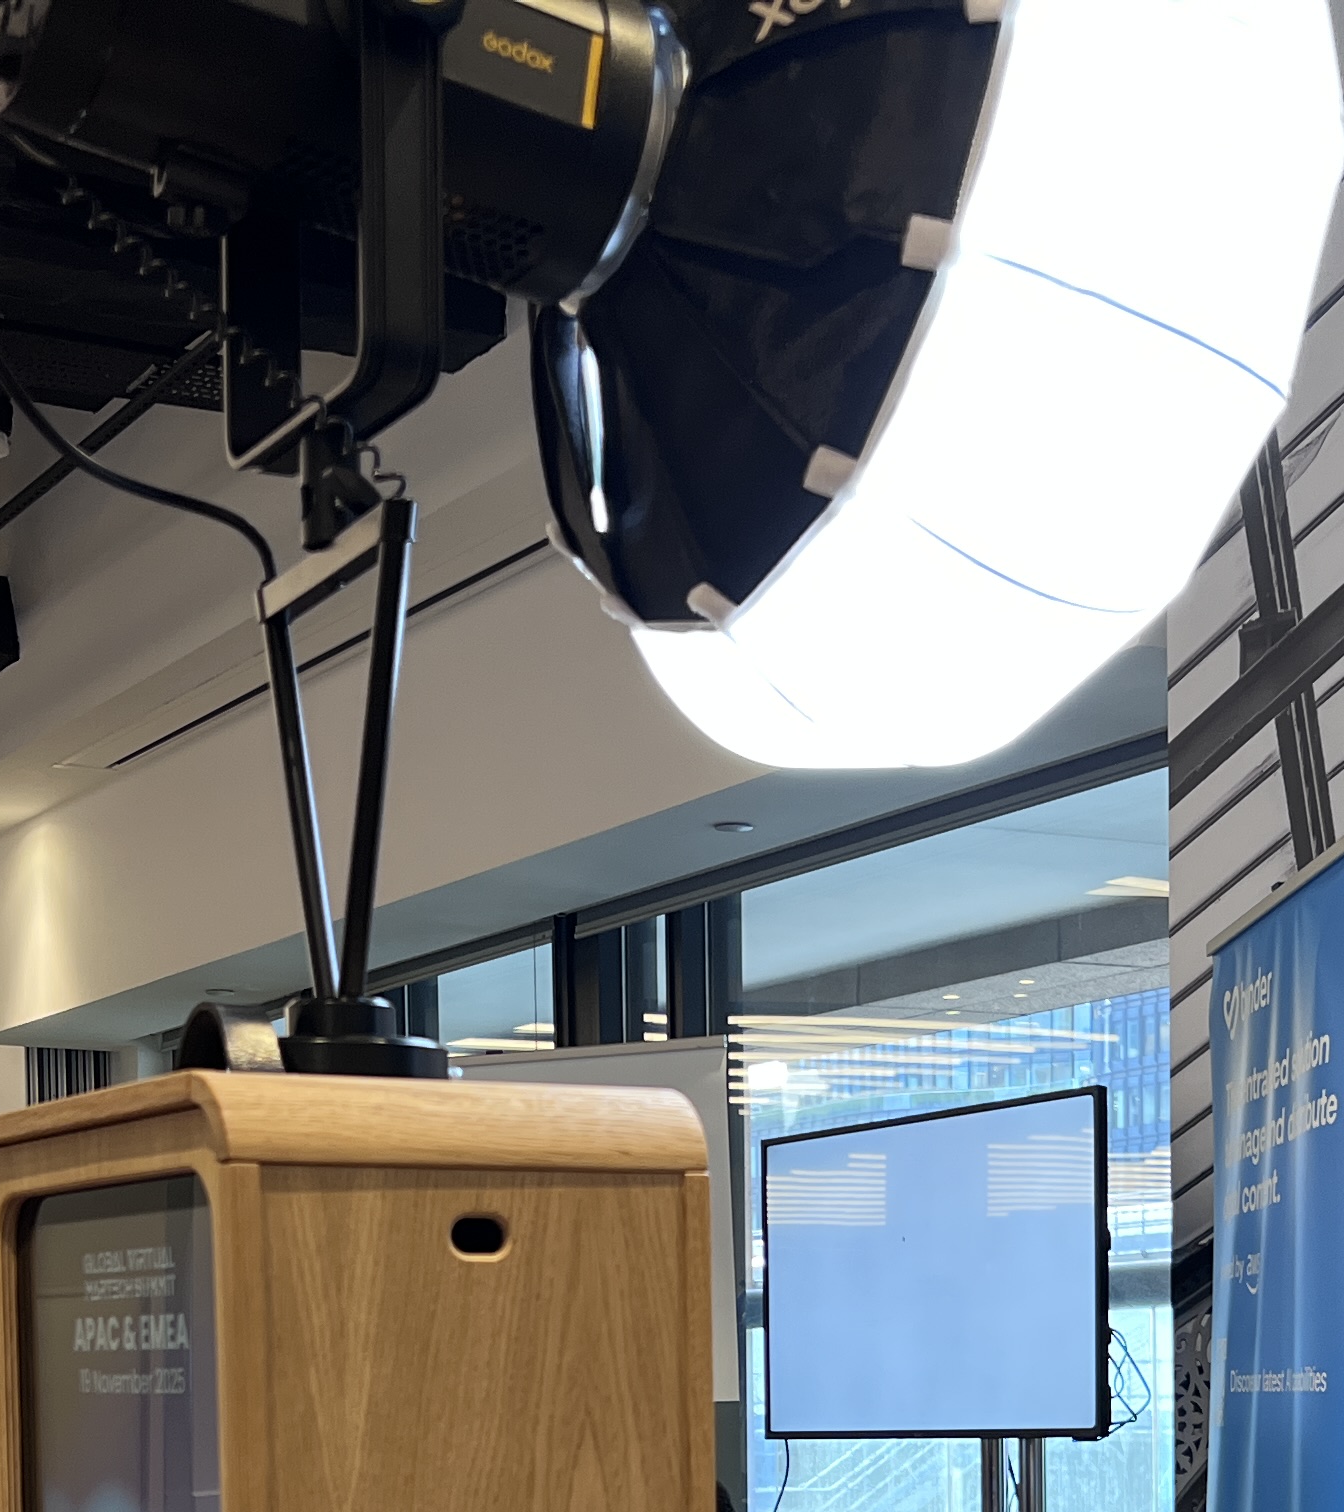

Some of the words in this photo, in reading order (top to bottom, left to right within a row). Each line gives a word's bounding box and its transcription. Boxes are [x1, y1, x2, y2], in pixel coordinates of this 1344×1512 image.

[73, 1316, 121, 1351] APAC
[123, 1315, 137, 1350] &
[139, 1312, 190, 1350] EMEA
[92, 1367, 154, 1394] November
[155, 1367, 187, 1394] 2025
